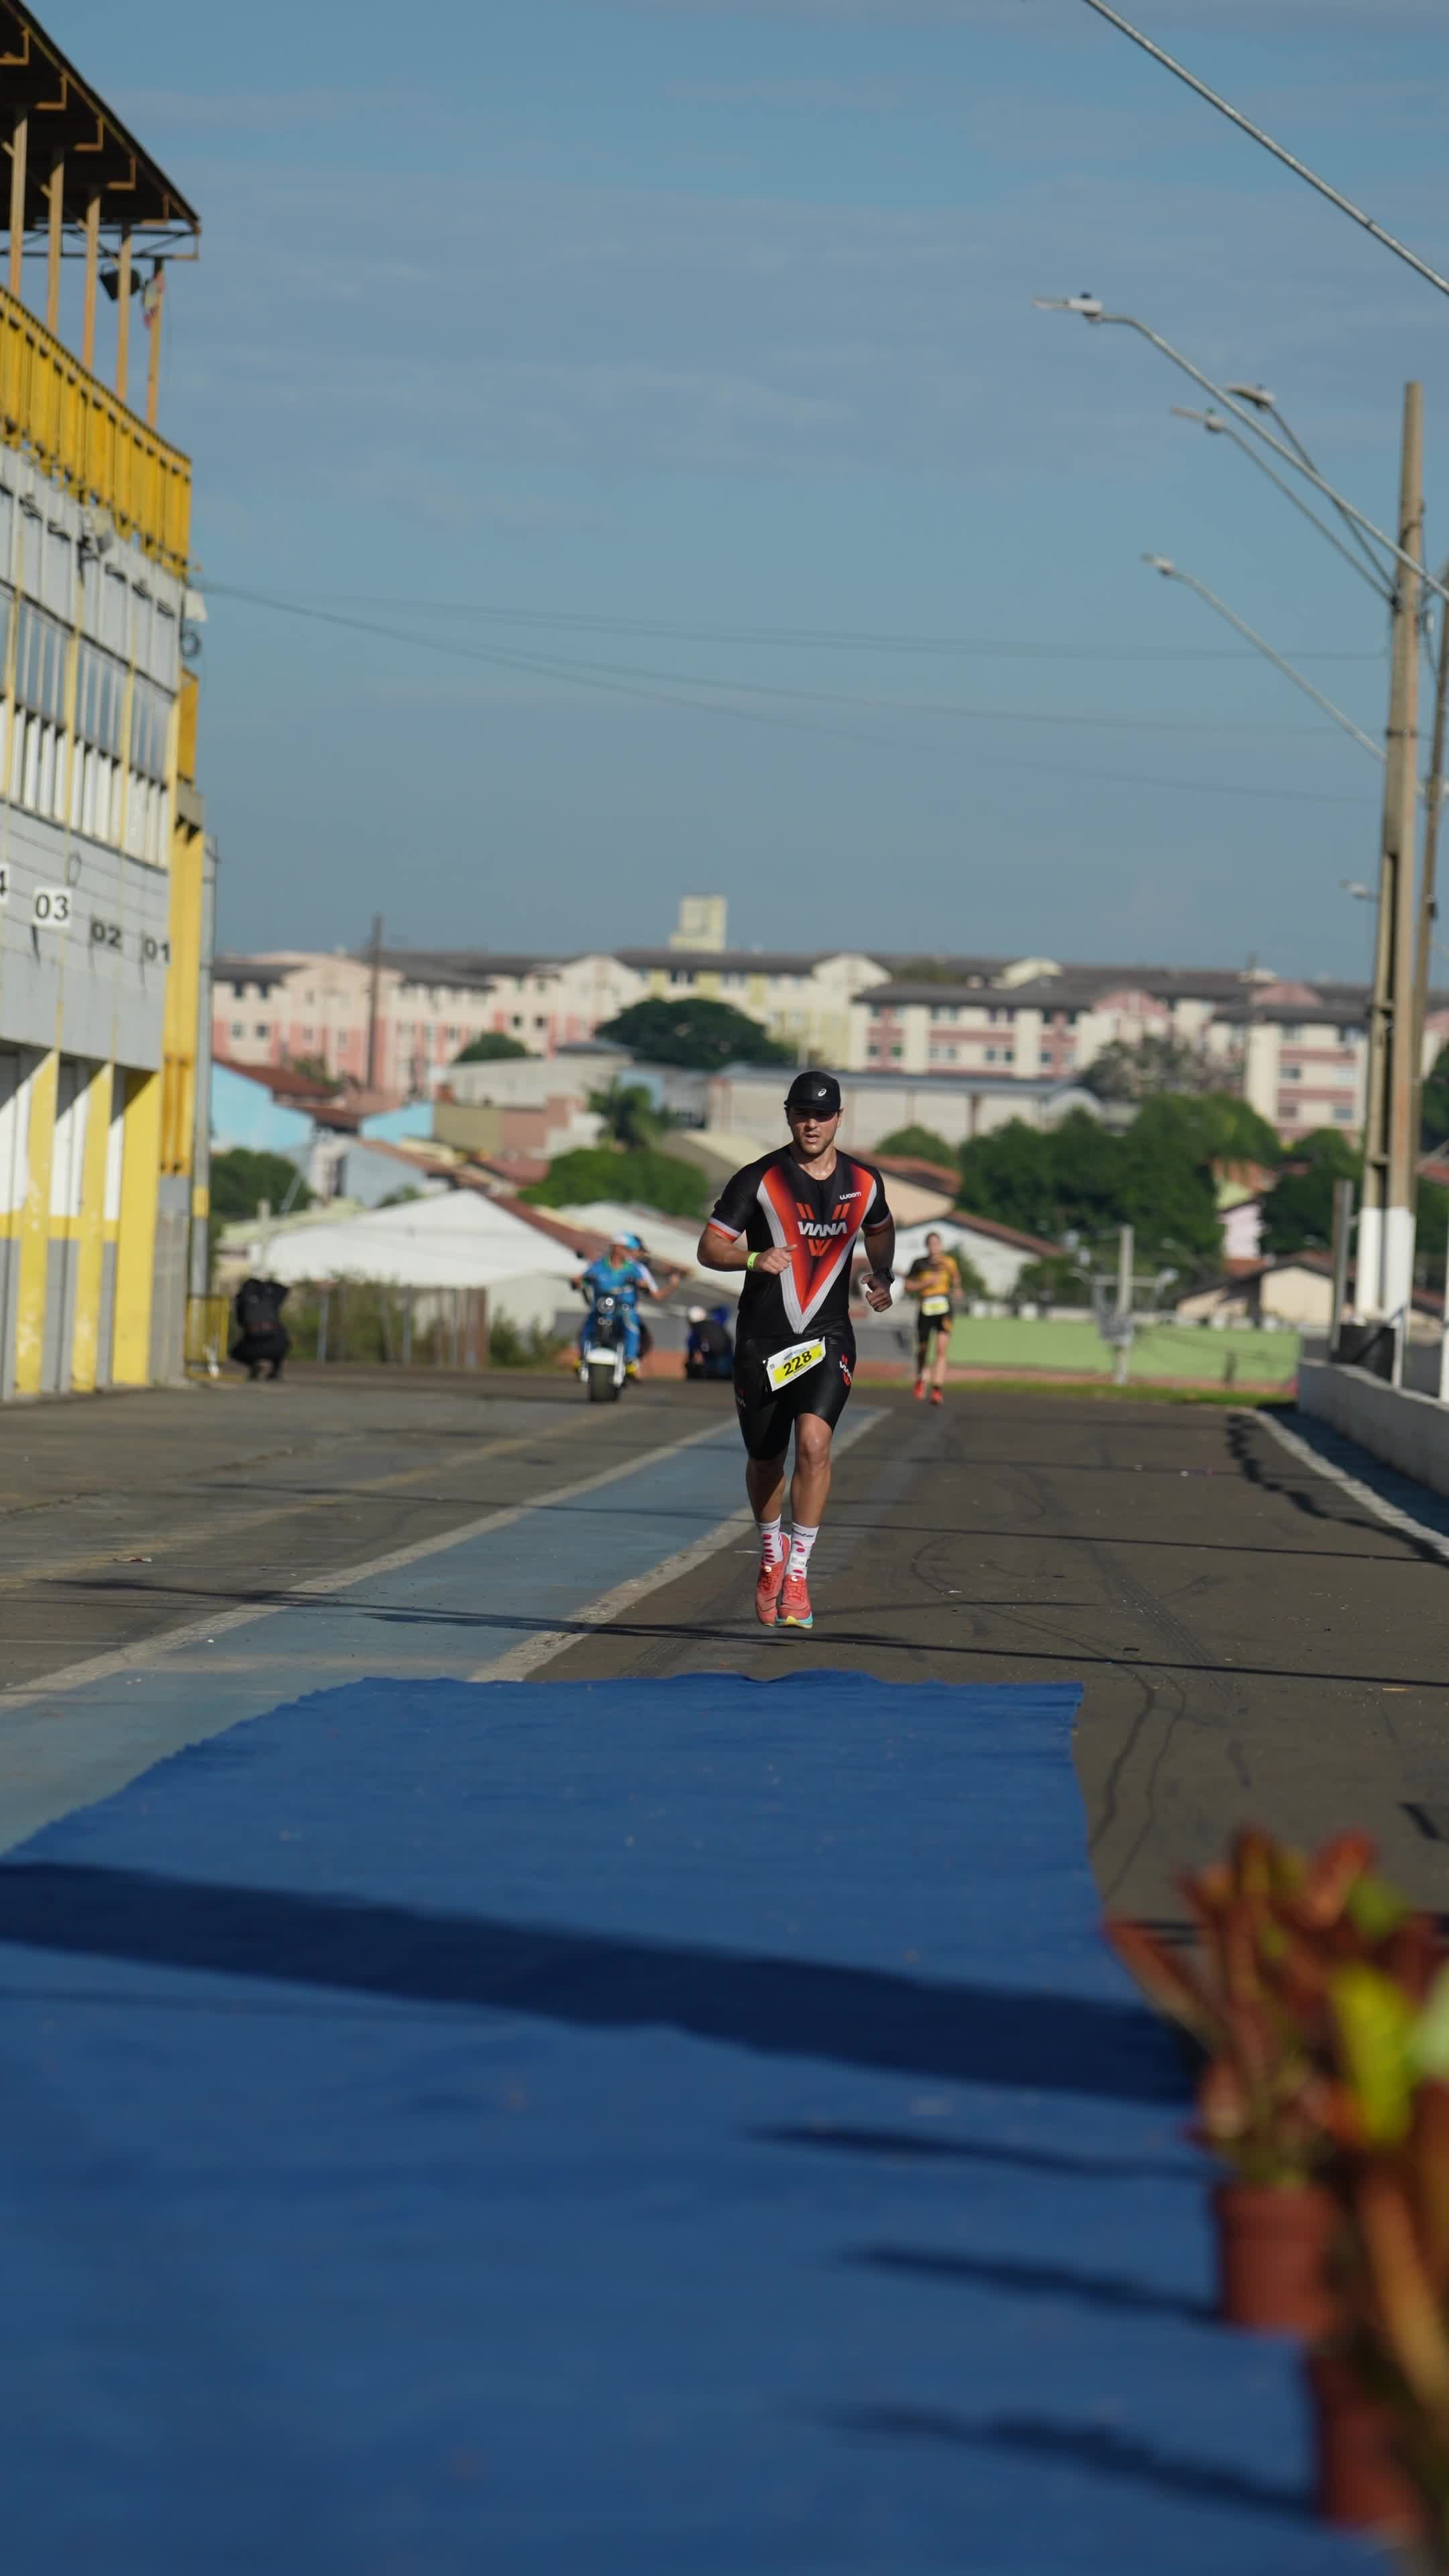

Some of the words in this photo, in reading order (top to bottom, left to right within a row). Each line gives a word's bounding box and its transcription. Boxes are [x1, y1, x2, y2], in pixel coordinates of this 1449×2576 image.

[36, 894, 69, 920] 03
[91, 920, 121, 950] 02
[144, 938, 170, 963] 01
[798, 1222, 847, 1237] VIANA
[784, 1351, 812, 1376] 228
